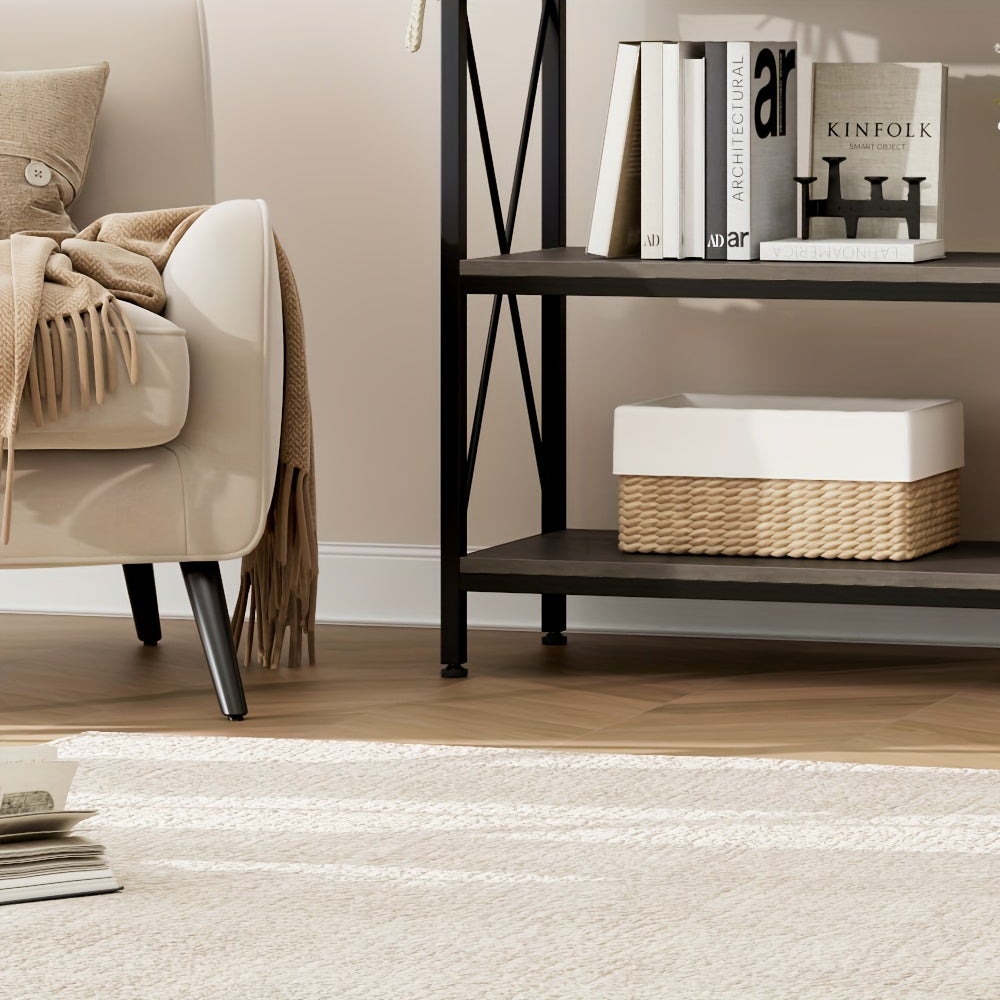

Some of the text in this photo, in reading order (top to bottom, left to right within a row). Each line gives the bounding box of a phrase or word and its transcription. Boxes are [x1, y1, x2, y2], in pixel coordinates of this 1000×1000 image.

[754, 48, 796, 139] ar
[732, 56, 744, 202] ARCHITECTURAL
[827, 122, 932, 138] KINFOLK
[644, 234, 660, 247] AD
[707, 234, 725, 248] AD
[727, 231, 749, 248] ar
[773, 246, 898, 260] LATINOAMERICA
